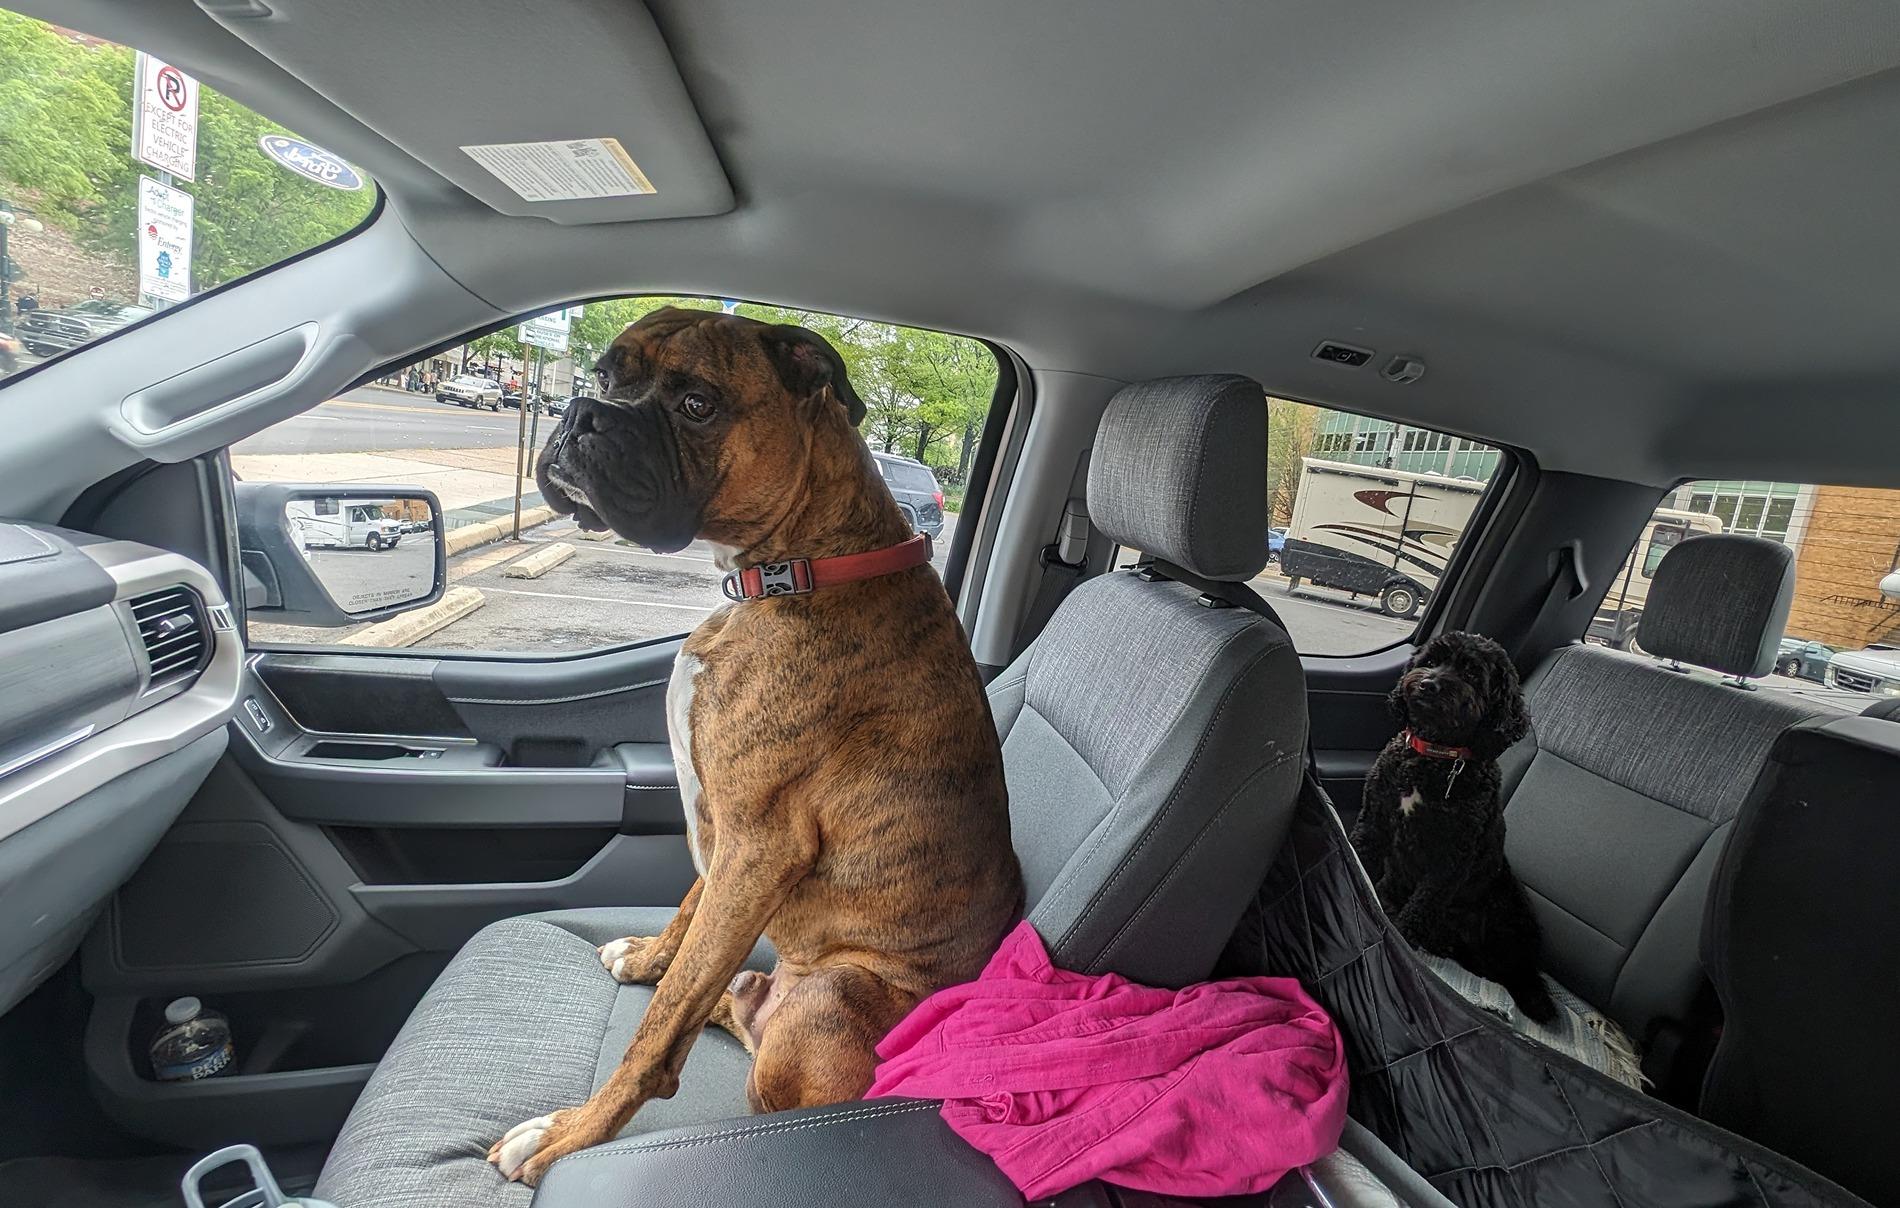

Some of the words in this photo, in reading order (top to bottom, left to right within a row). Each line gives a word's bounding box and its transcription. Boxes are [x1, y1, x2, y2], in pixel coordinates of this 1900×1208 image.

[145, 102, 176, 124] EXCEPT
[178, 120, 193, 133] FOR
[152, 120, 187, 144] ELECTRIC
[153, 134, 186, 157] VEHICLE
[146, 146, 190, 172] CHARGING
[192, 1057, 231, 1080] PARK
